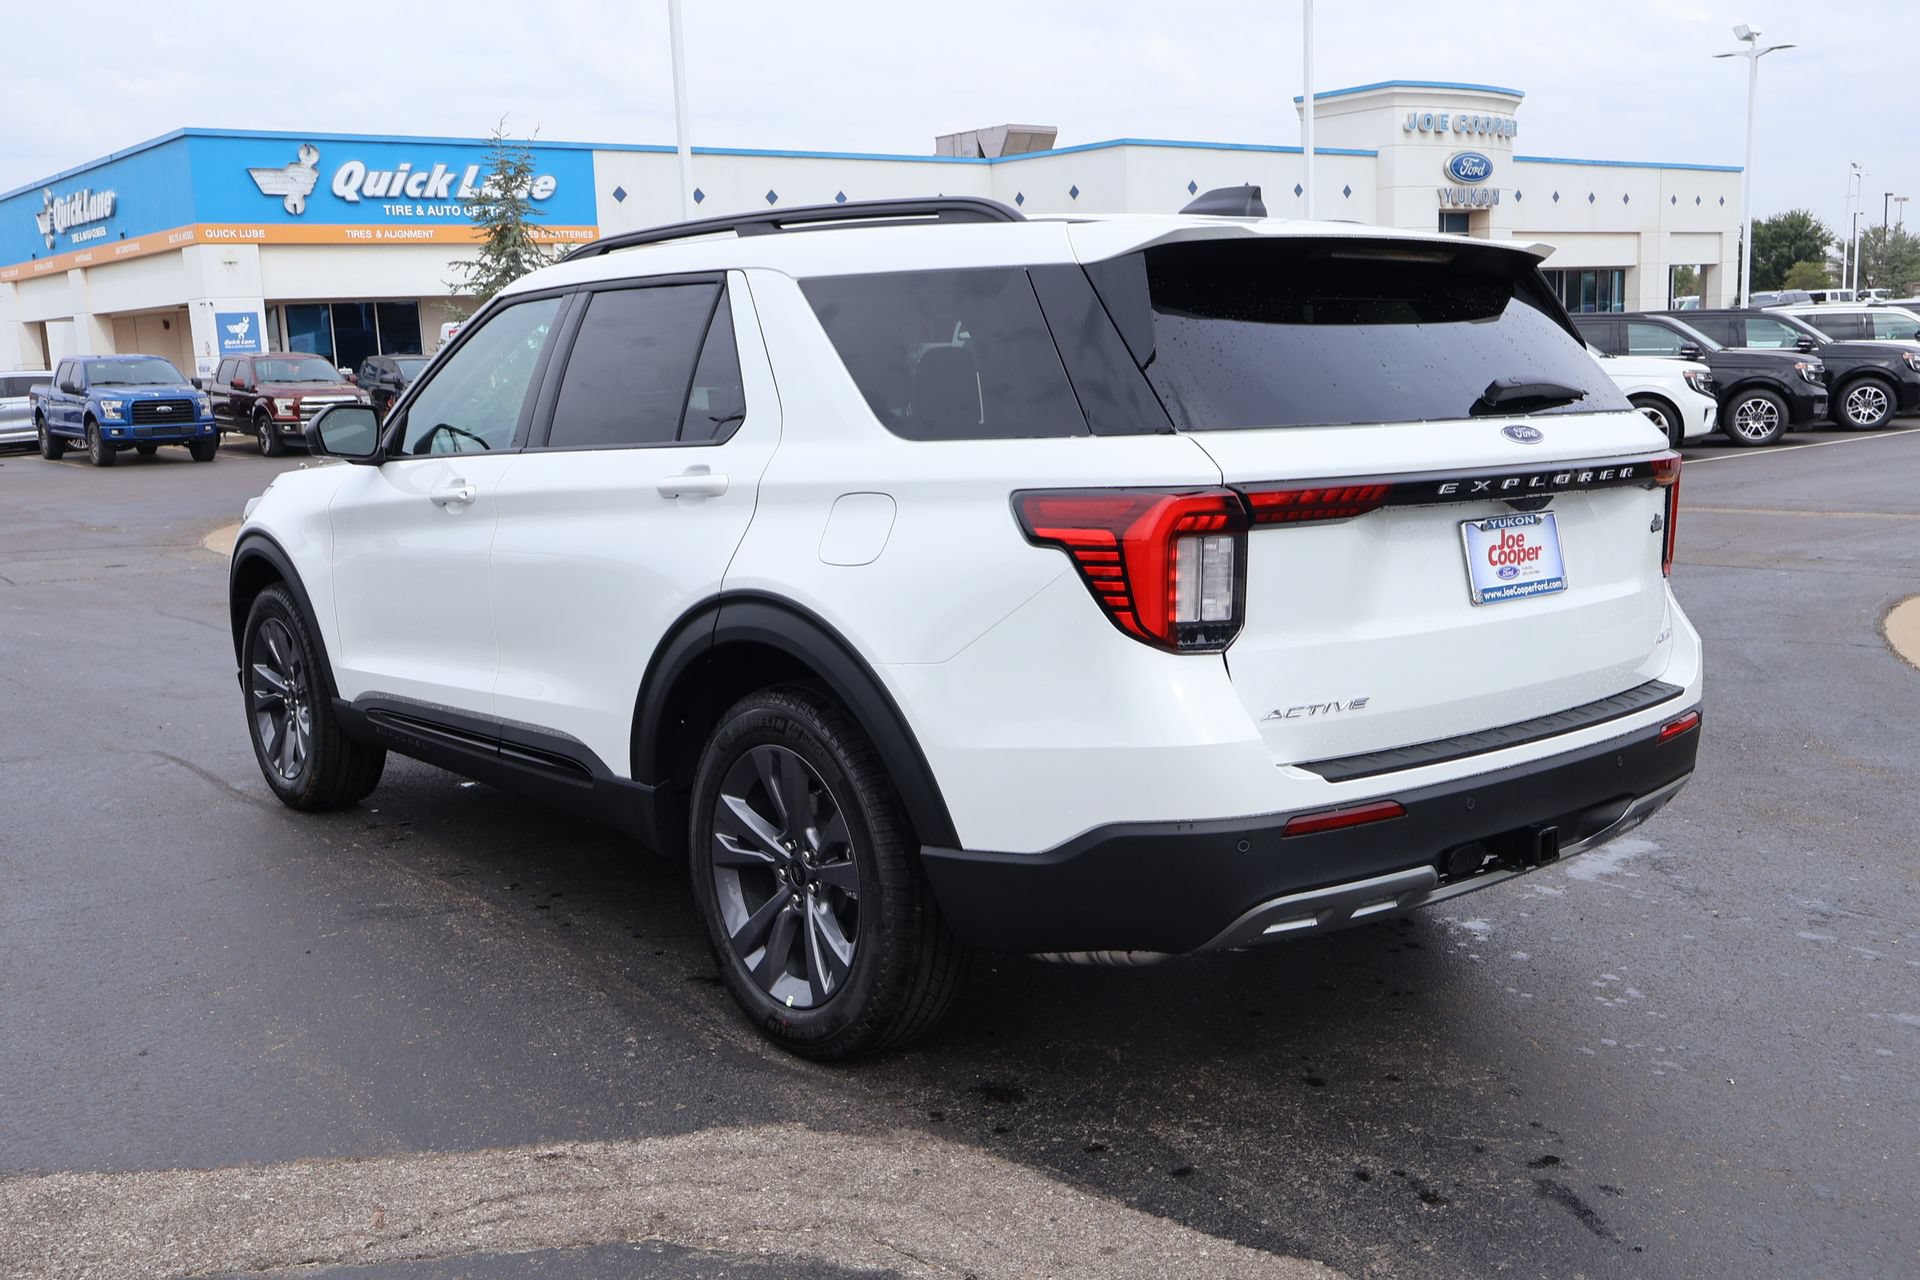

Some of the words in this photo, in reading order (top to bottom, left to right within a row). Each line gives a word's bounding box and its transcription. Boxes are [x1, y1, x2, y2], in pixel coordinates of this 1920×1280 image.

[1403, 112, 1449, 133] JOE
[331, 160, 457, 203] Quick
[1439, 188, 1499, 207] YUKON
[53, 191, 83, 233] Quick
[83, 188, 116, 222] Lane
[384, 205, 412, 216] TIRE
[416, 205, 424, 216] &
[427, 205, 461, 217] AUTO
[205, 229, 237, 239] QUICK
[239, 229, 265, 238] LUBE
[345, 229, 372, 239] TIRES
[376, 230, 382, 239] &
[384, 230, 434, 239] ALIGNMENT
[1438, 467, 1635, 495] EXPLORER
[1490, 515, 1535, 528] YUKON
[1498, 528, 1525, 550] Joe
[1488, 544, 1542, 566] Cooper
[1483, 579, 1562, 599] www.JoeCooperFord.com
[1260, 697, 1370, 721] ACTIVE
